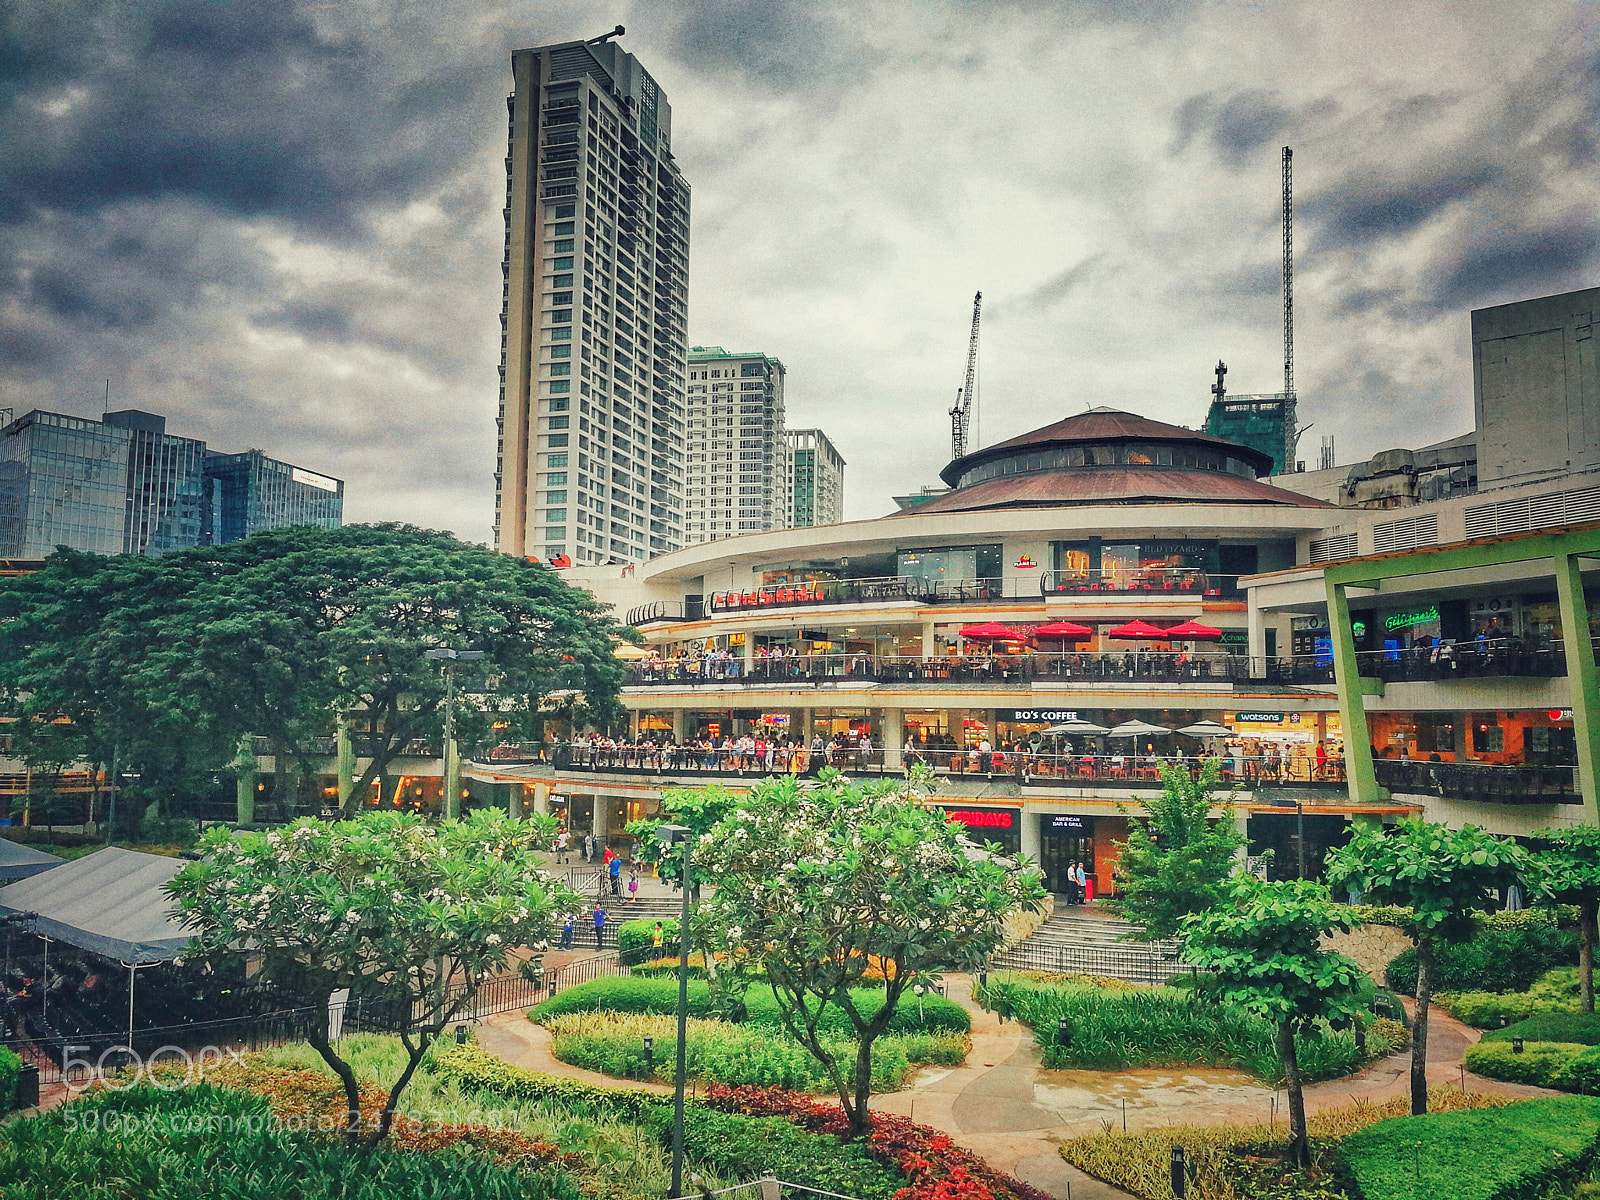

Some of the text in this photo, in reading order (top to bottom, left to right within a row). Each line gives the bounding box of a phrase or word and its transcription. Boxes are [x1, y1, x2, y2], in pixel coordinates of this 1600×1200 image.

[1015, 711, 1077, 720] BO'S COFFEE
[1240, 713, 1280, 721] watsons
